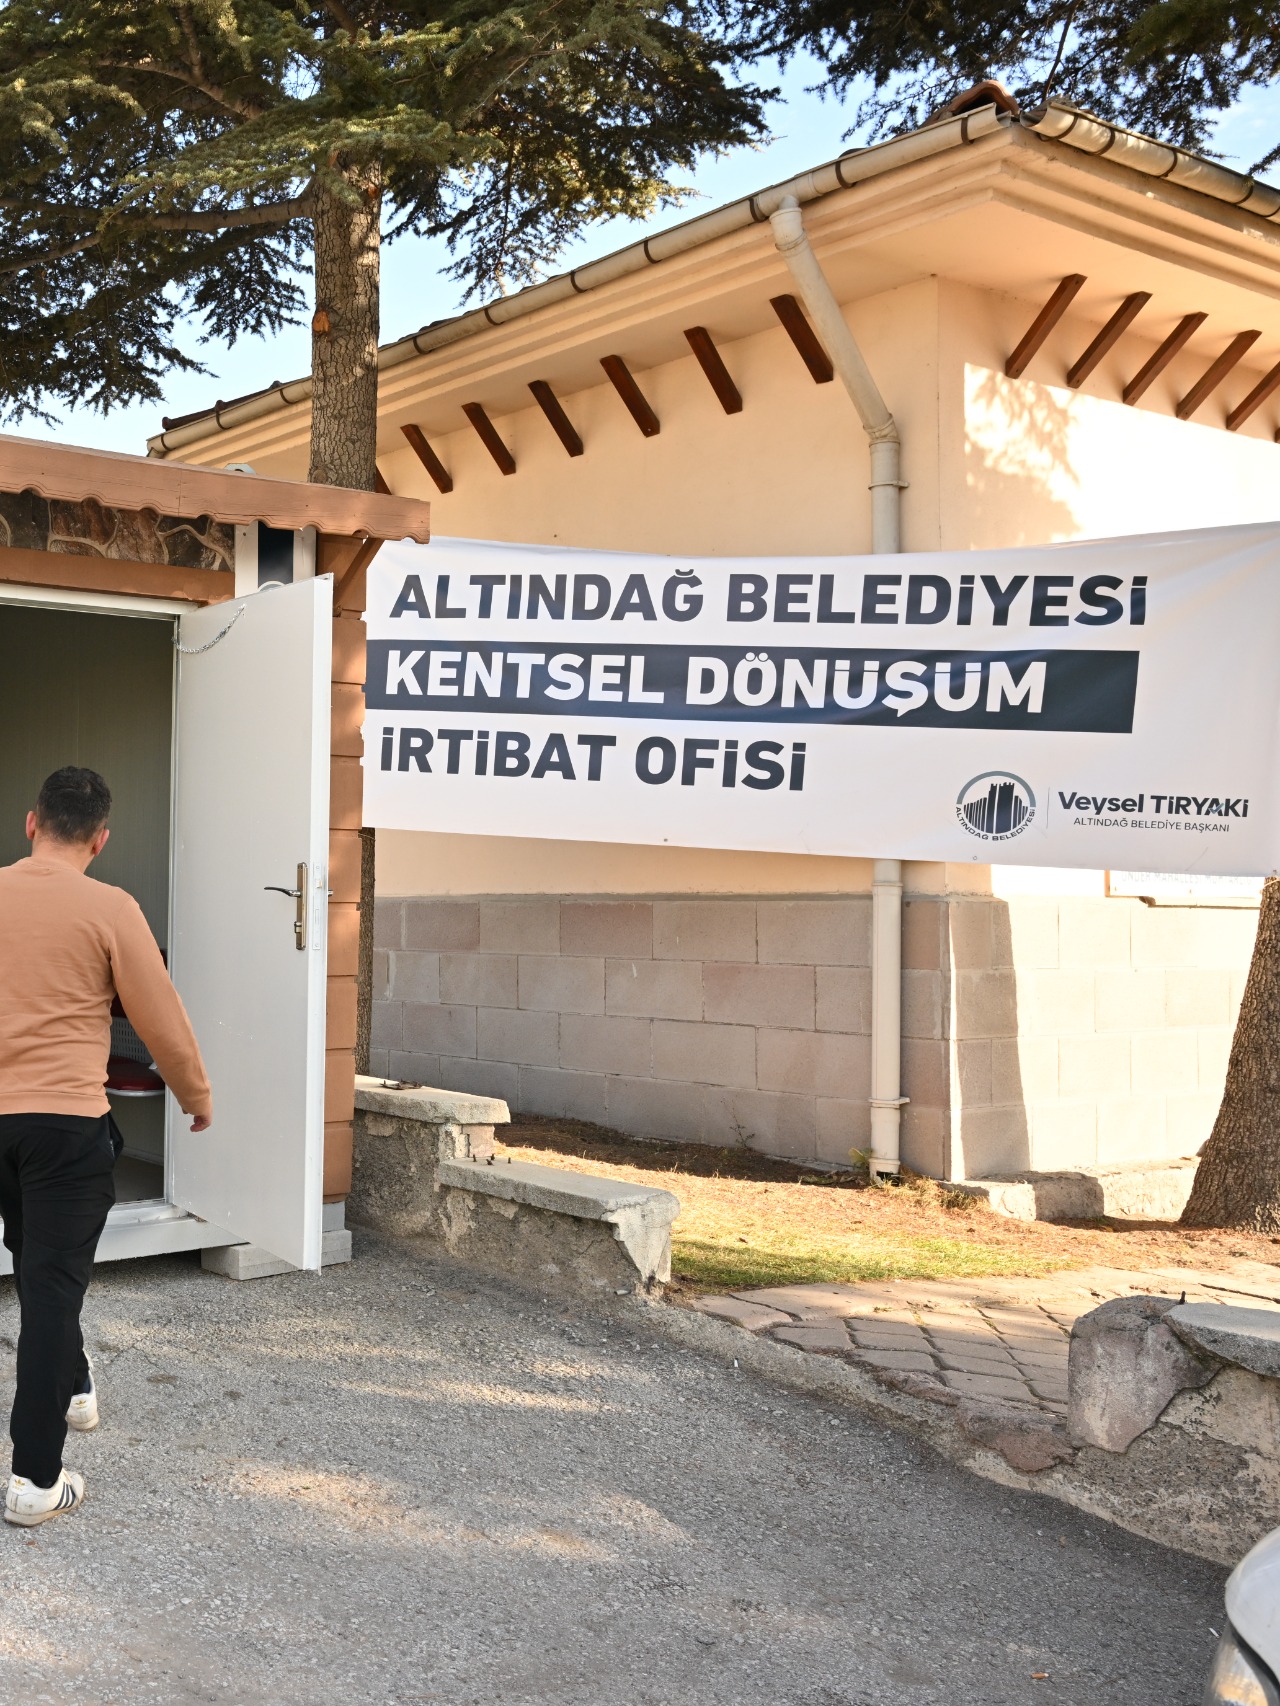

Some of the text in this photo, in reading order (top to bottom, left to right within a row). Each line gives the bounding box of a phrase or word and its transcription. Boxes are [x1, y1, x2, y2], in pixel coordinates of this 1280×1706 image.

[389, 569, 1148, 627] ALTINDAĞ BELEDİYESİ
[385, 649, 1048, 717] KENTSEL DÖNÜŞÜM
[380, 726, 807, 791] İRTİBAT OFİSİ
[1058, 791, 1145, 815] Veysel
[1073, 816, 1230, 834] ALTINDAĞ BELEDİYE BAŞKANI
